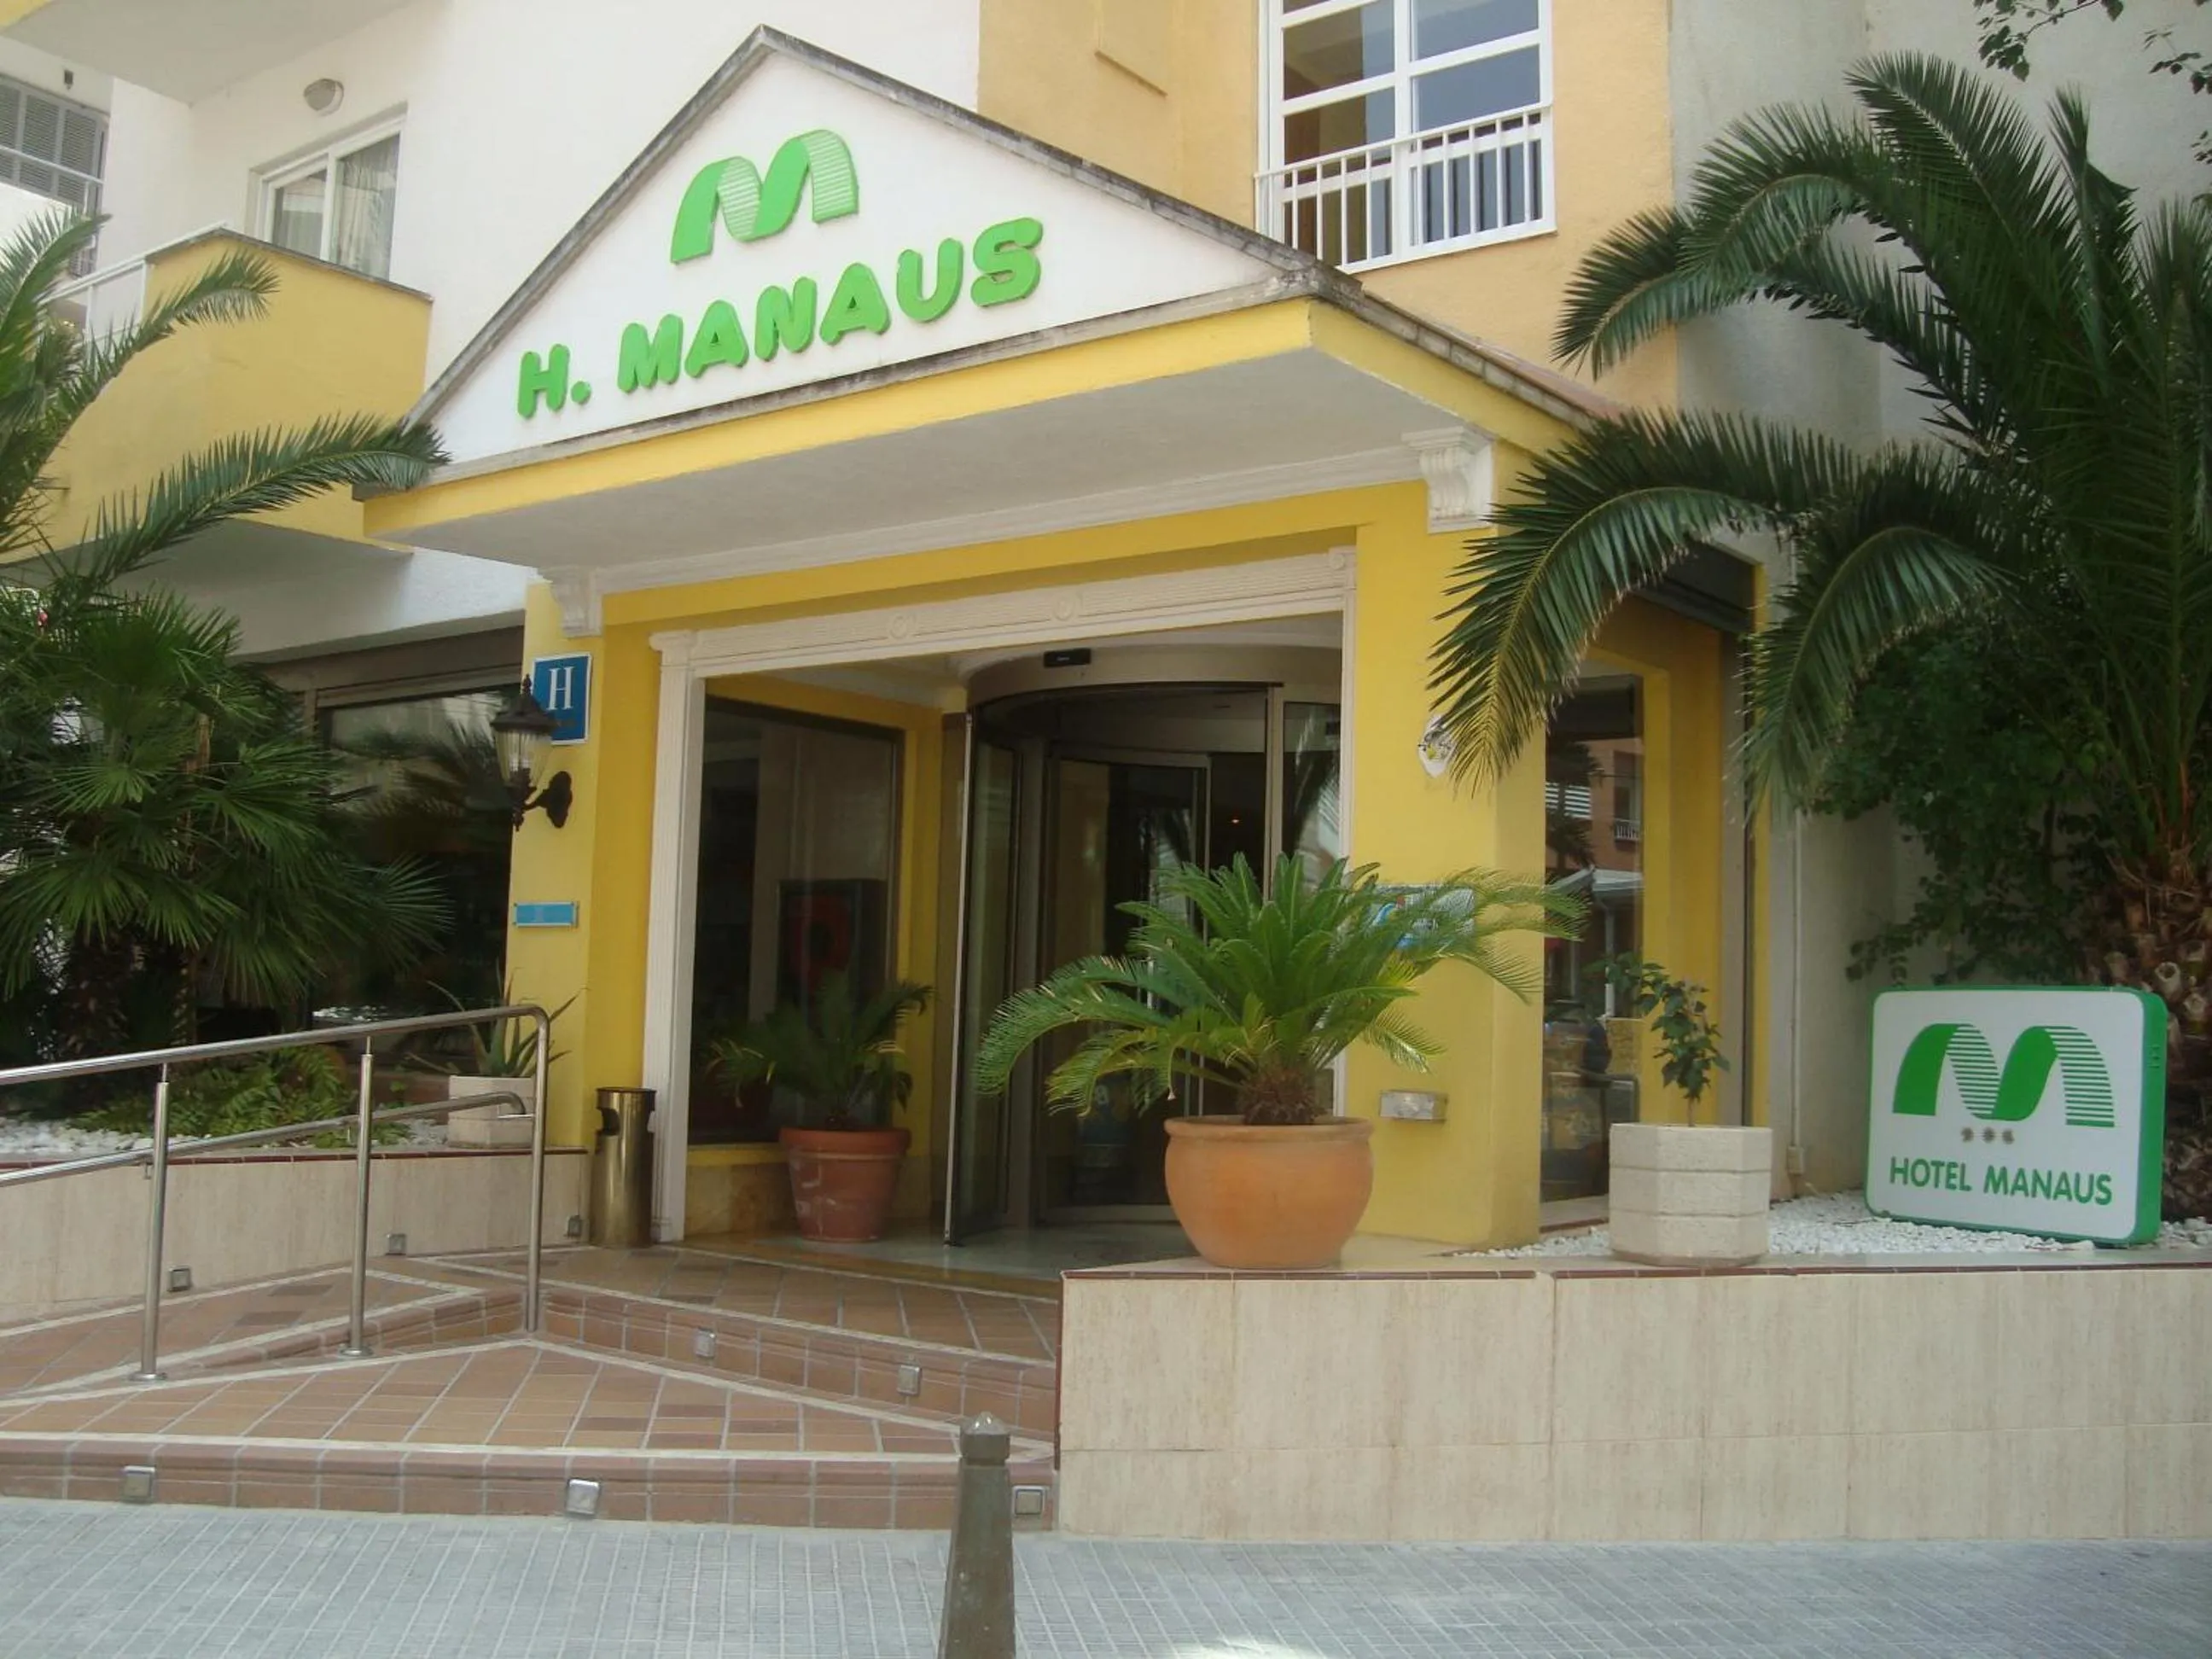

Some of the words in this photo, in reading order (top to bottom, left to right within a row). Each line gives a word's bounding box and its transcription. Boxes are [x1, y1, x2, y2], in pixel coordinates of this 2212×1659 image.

[517, 344, 591, 419] H.
[617, 217, 1043, 393] MANAUS
[546, 666, 574, 710] H
[1889, 1156, 1973, 1192] HOTEL
[1983, 1165, 2113, 1206] MANAUS
